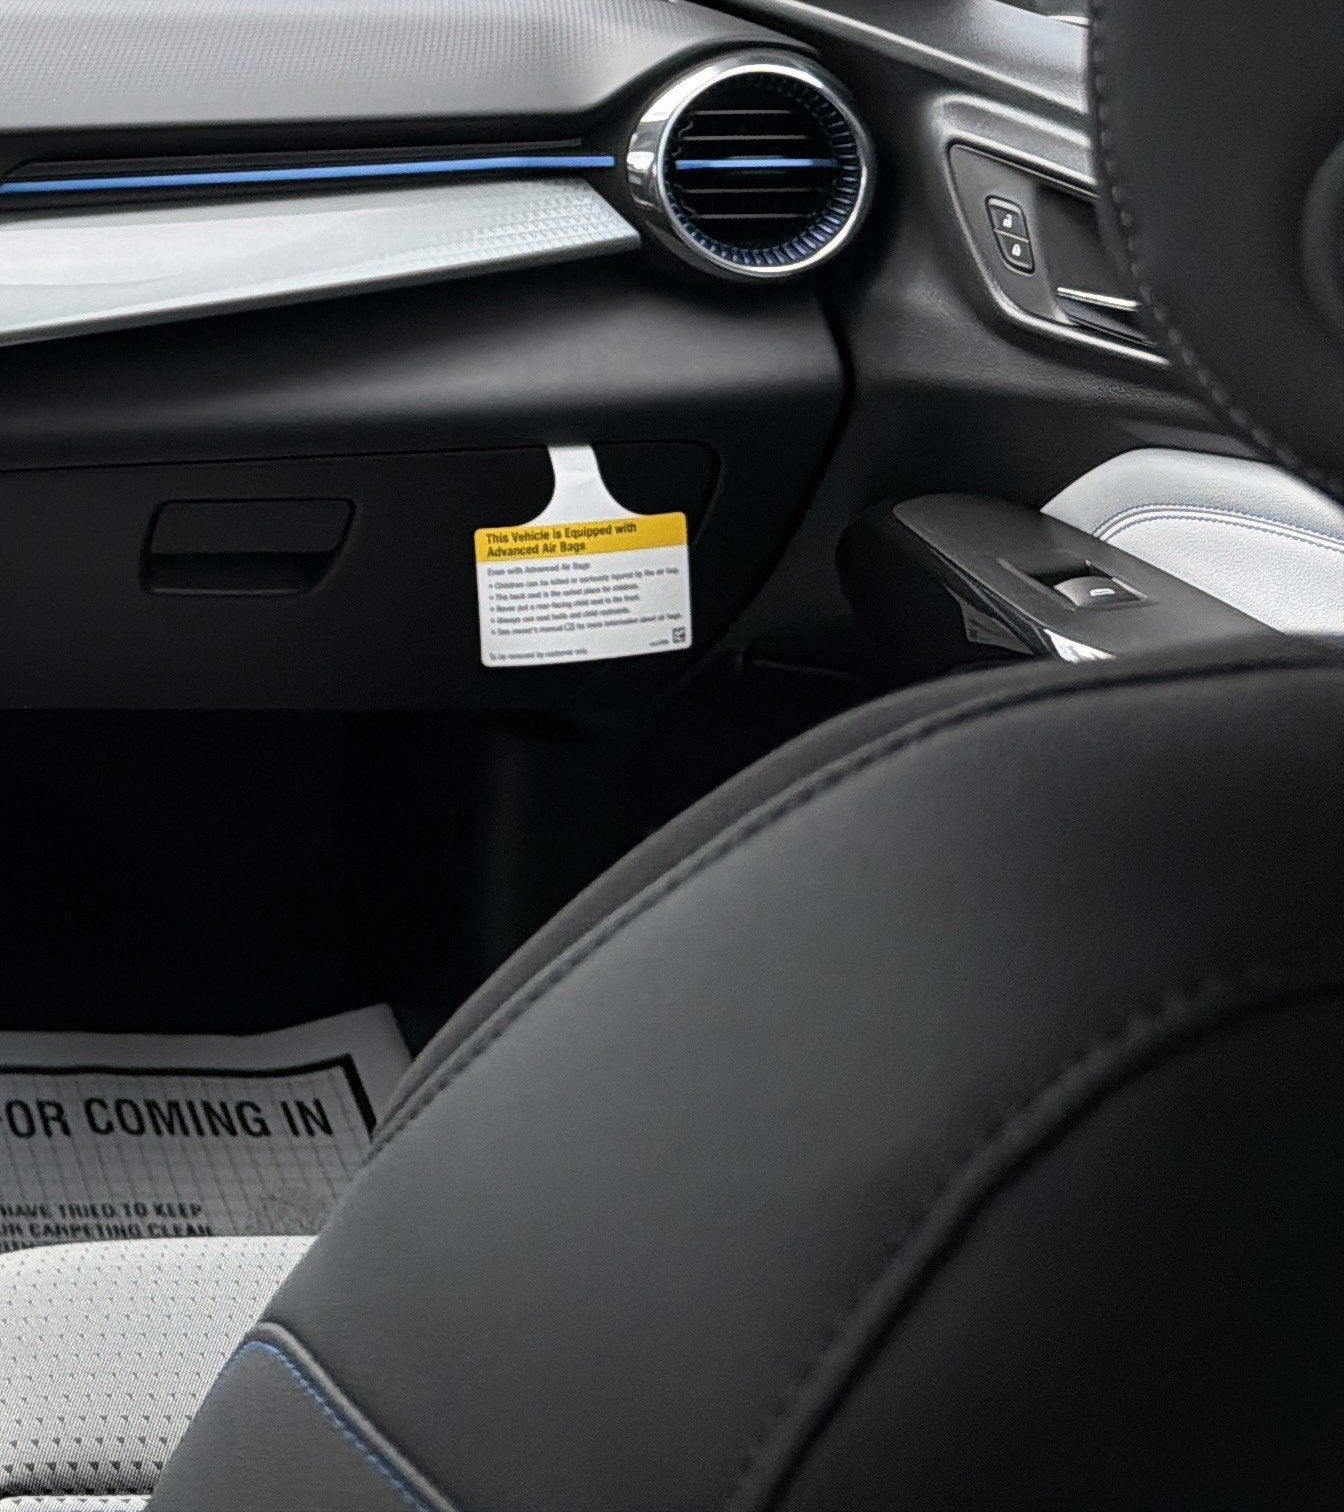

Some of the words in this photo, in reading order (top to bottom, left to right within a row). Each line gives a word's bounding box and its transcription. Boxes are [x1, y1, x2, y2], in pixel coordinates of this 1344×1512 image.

[486, 533, 509, 545] This
[511, 530, 550, 543] Vehicle
[552, 529, 562, 540] is
[564, 525, 613, 540] Equipped
[615, 522, 637, 535] with
[486, 544, 540, 558] Advanced
[542, 543, 557, 554] Air
[560, 541, 586, 555] Bags
[84, 1096, 271, 1139] COMING
[285, 1098, 334, 1138] IN
[0, 1203, 50, 1218] HAVE
[59, 1203, 116, 1219] TRIED
[121, 1202, 148, 1218] TO
[153, 1201, 204, 1219] KEEP
[29, 1222, 142, 1238] CARPETING
[146, 1222, 213, 1238] CLEAN
